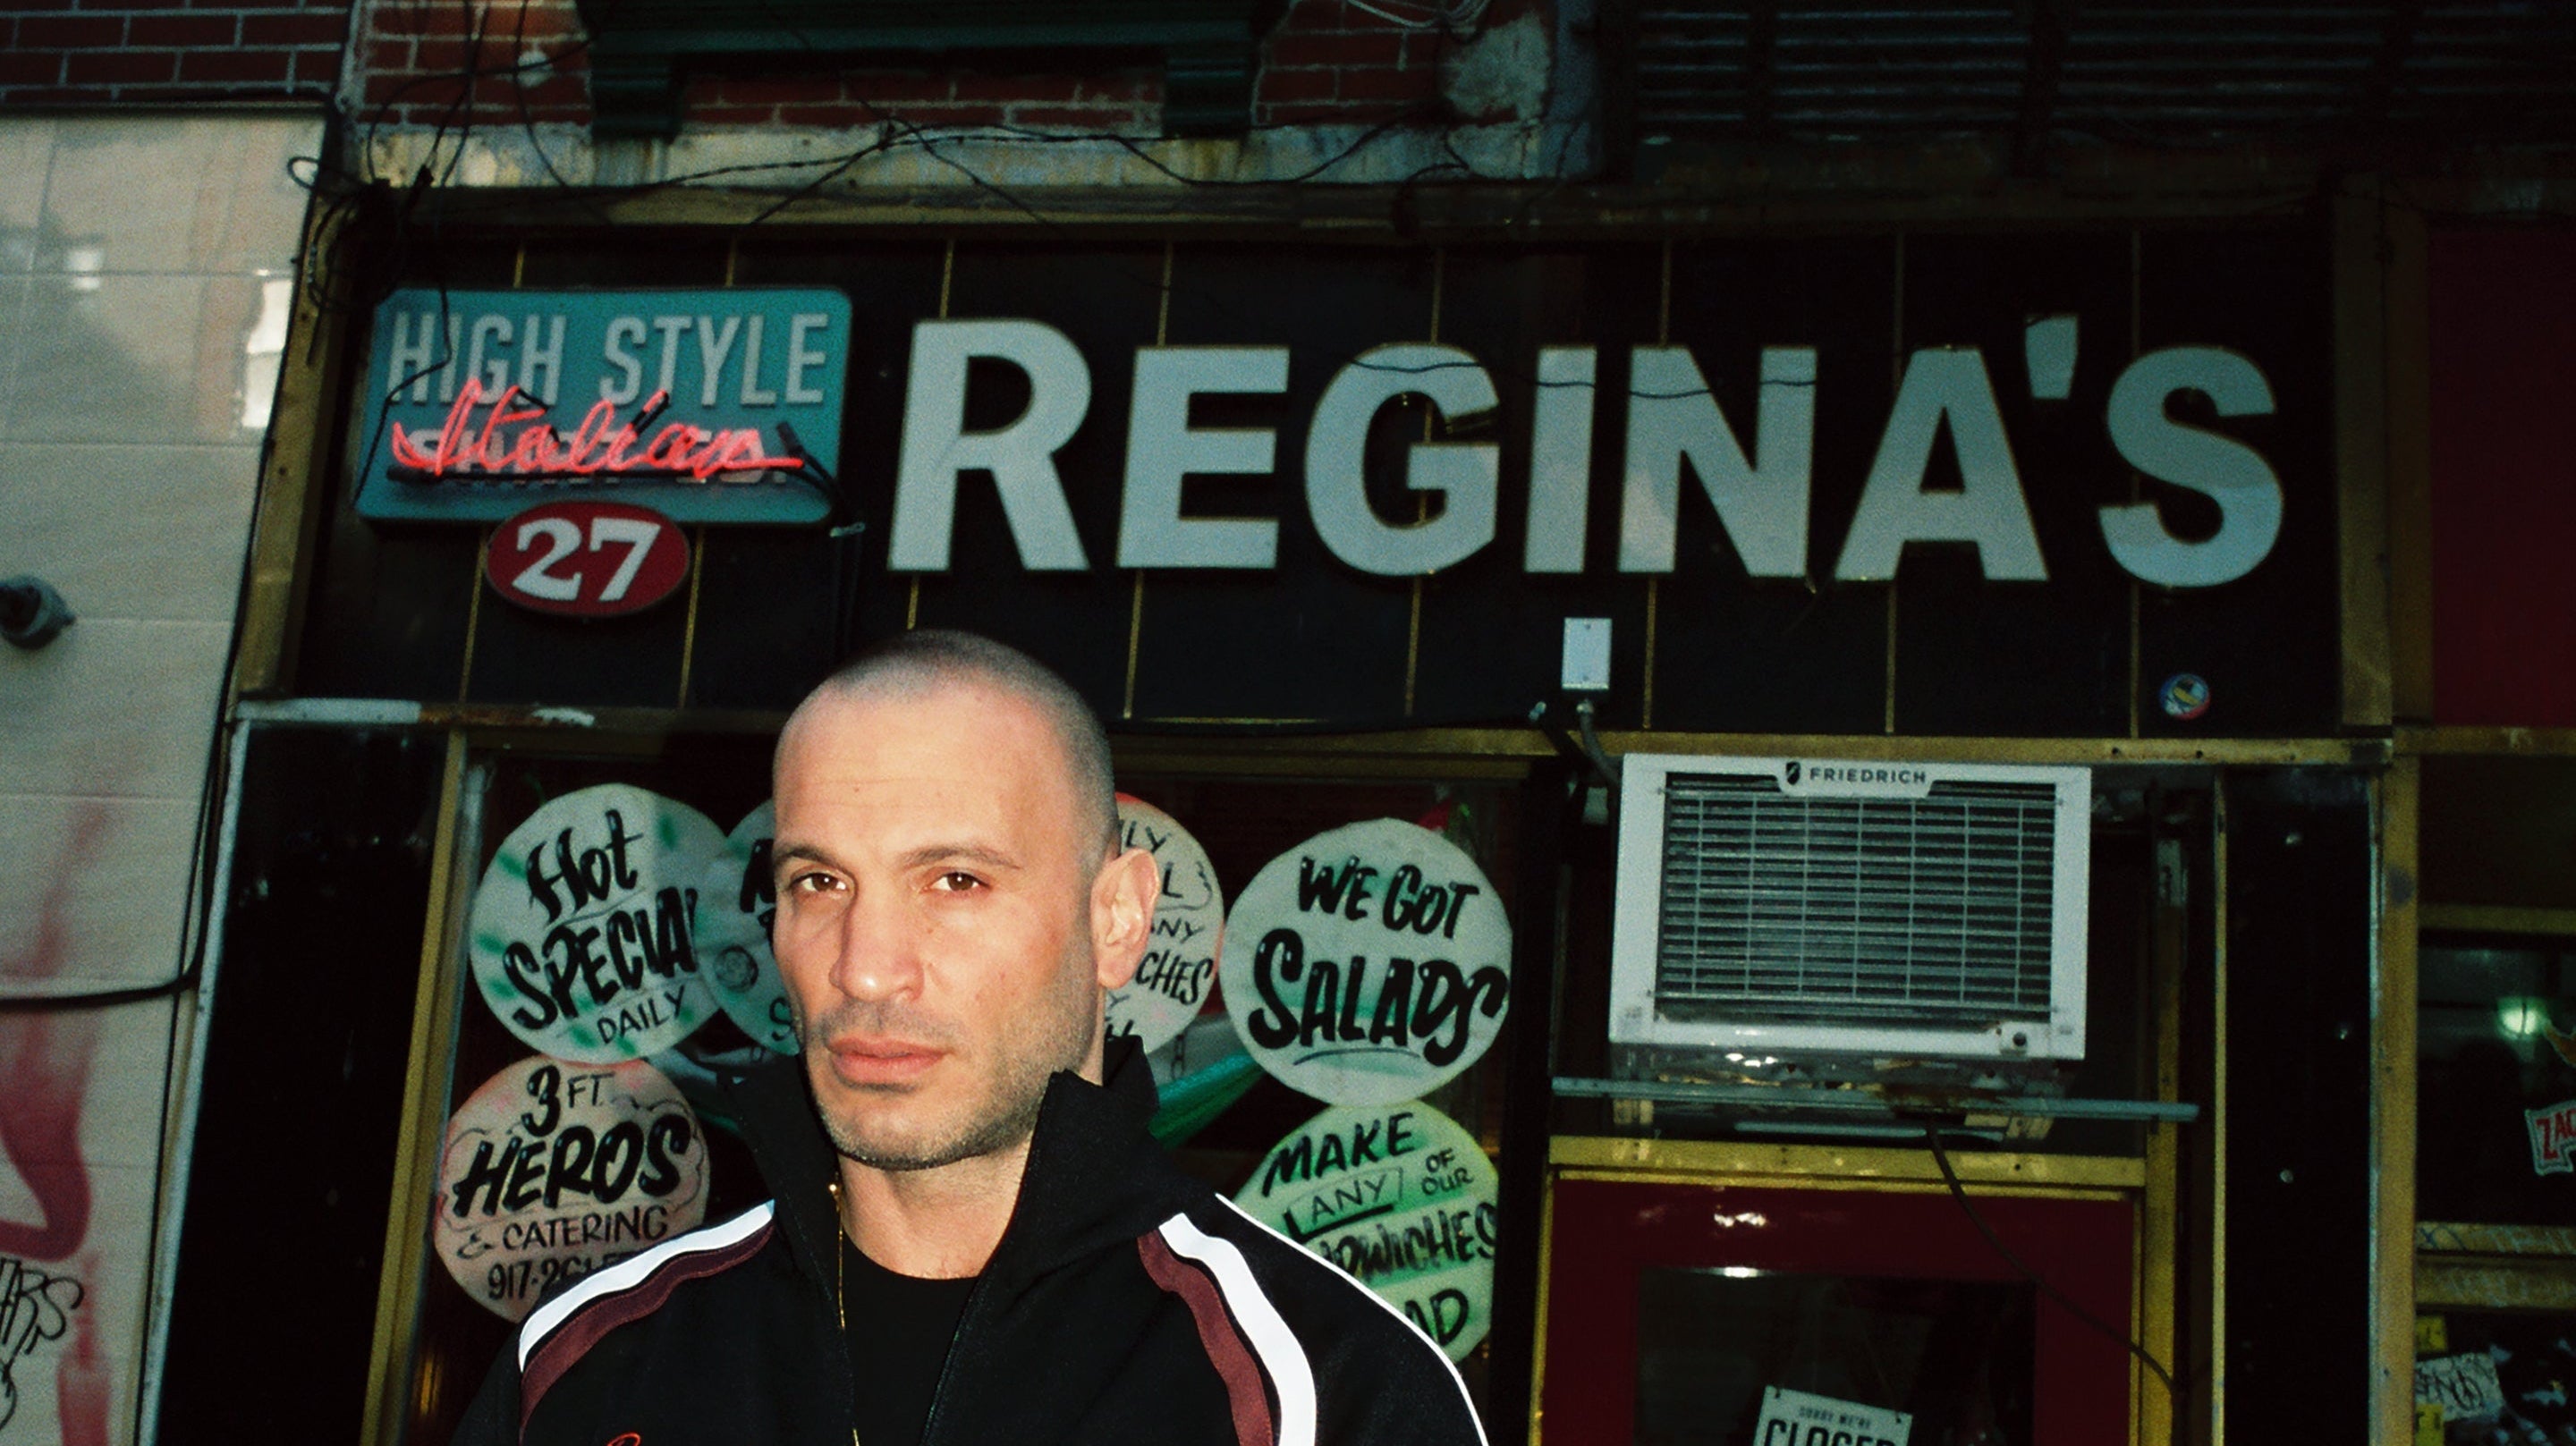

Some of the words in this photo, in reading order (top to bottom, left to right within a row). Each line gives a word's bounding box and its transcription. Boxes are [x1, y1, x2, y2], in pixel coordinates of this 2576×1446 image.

[386, 311, 567, 407] HIGH
[599, 312, 830, 407] STYLE
[392, 378, 805, 478] Italian
[886, 314, 2284, 589] REGINA'S
[511, 516, 662, 604] 27
[1809, 766, 1927, 783] FRIEDRICH
[526, 809, 643, 923] Hot
[1299, 855, 1377, 920] WE
[1383, 864, 1479, 939] GOT
[1150, 918, 1205, 943] NY
[597, 985, 685, 1044] DAILY
[1249, 928, 1510, 1067] SALADS
[521, 1064, 560, 1137] 3
[453, 1113, 691, 1217] HEROS
[1262, 1112, 1414, 1197] MAKE
[1421, 1168, 1473, 1196] OUR
[1426, 1147, 1455, 1173] OF
[503, 1205, 667, 1250] CATERING
[1311, 1173, 1386, 1226] ANY
